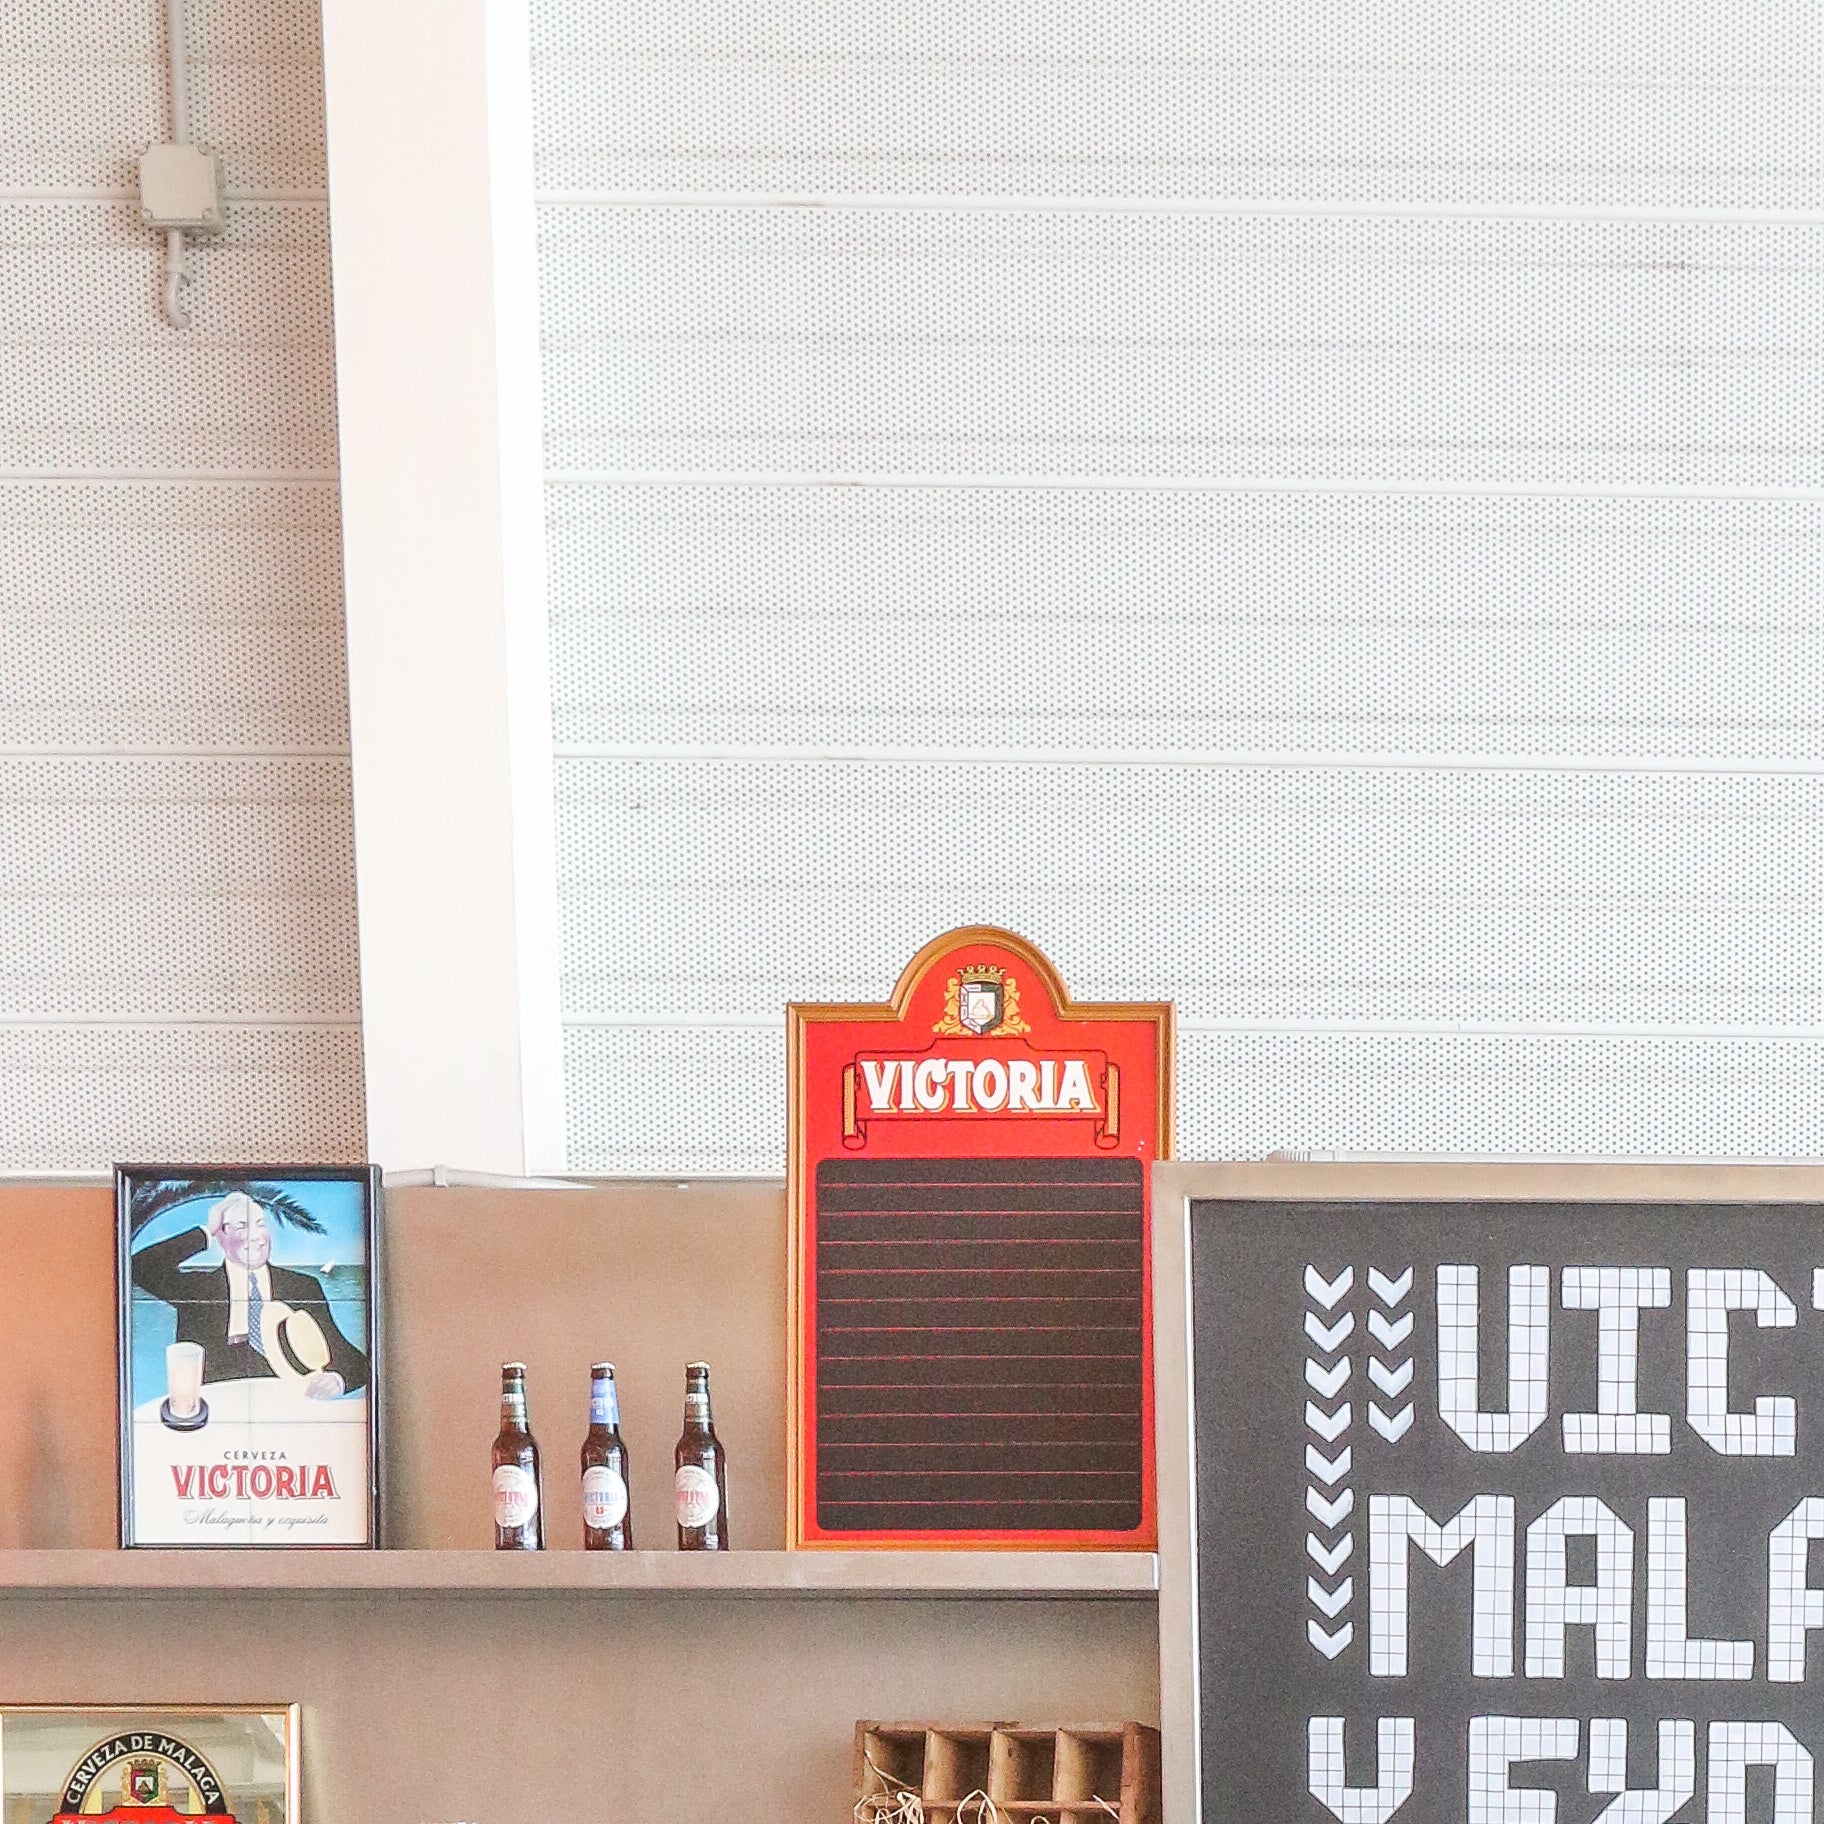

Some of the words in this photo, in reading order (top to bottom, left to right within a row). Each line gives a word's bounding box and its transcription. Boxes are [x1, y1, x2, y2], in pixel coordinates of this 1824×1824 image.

[860, 1059, 1100, 1114] VICTORIA
[224, 1451, 287, 1460] CERVEZA
[170, 1464, 341, 1499] VICTORIA
[66, 1739, 127, 1805] CERVEZA
[130, 1735, 153, 1750] DE
[160, 1738, 220, 1805] MALAGA
